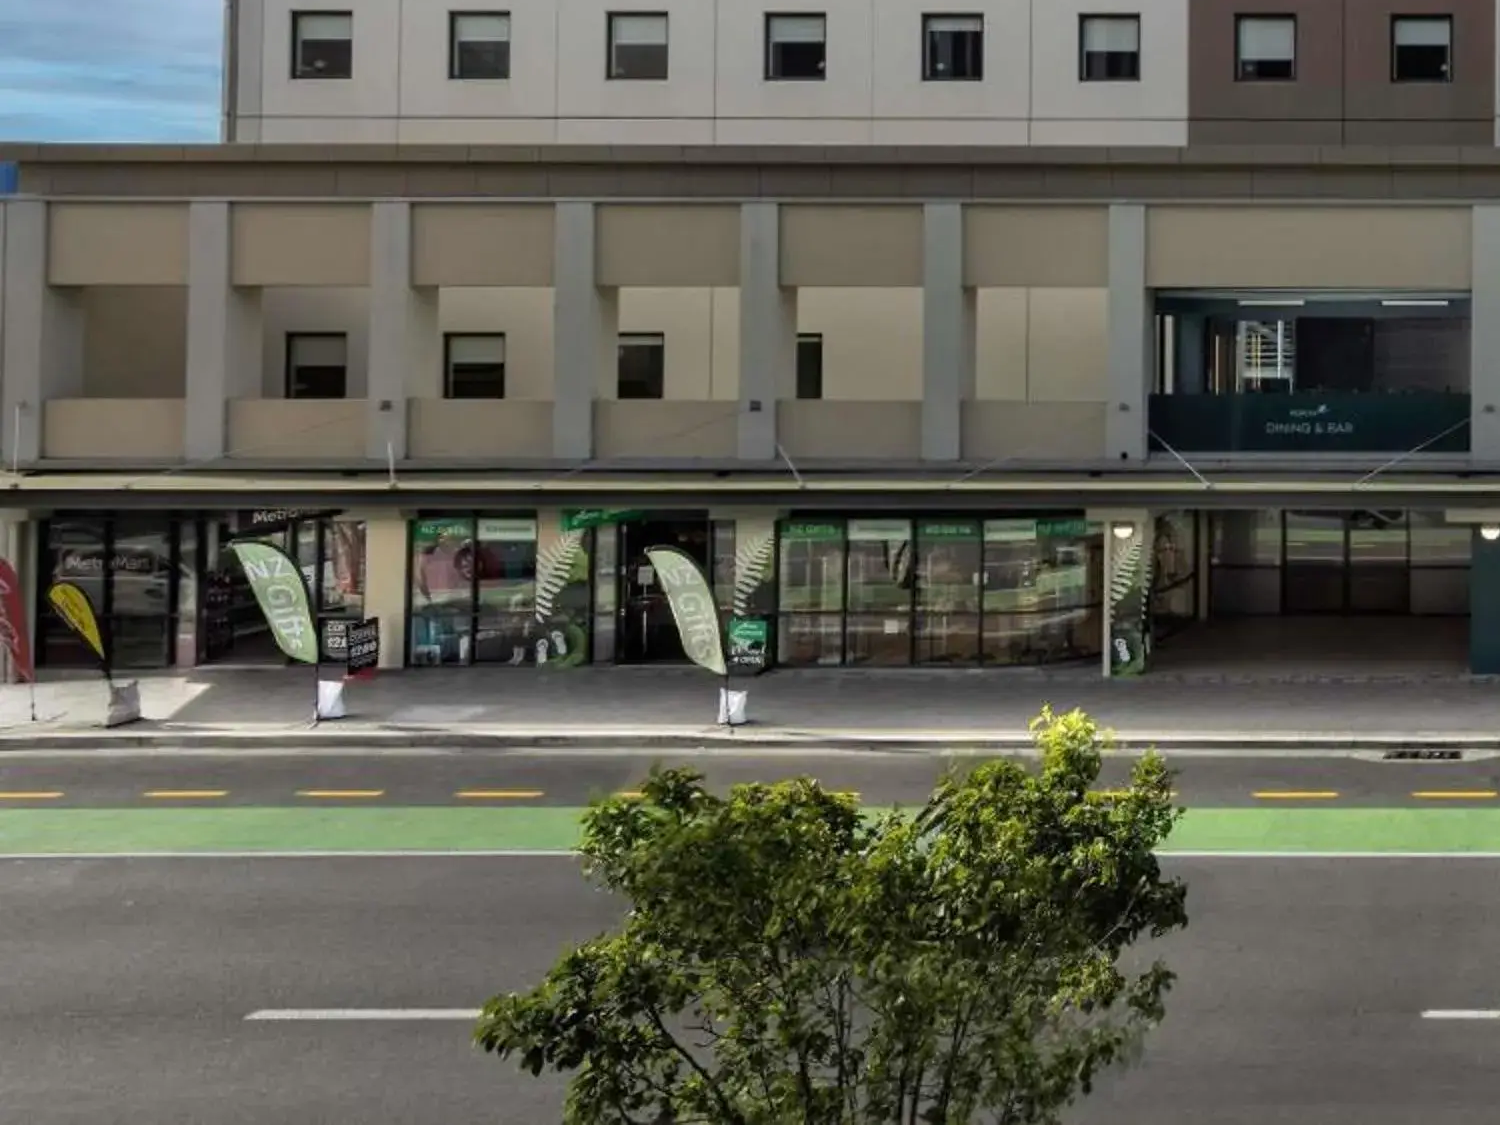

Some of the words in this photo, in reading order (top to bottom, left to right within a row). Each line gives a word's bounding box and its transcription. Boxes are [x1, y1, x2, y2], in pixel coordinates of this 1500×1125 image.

[244, 555, 288, 583] NZ
[266, 584, 306, 651] Gifts
[677, 592, 714, 658] Gifts
